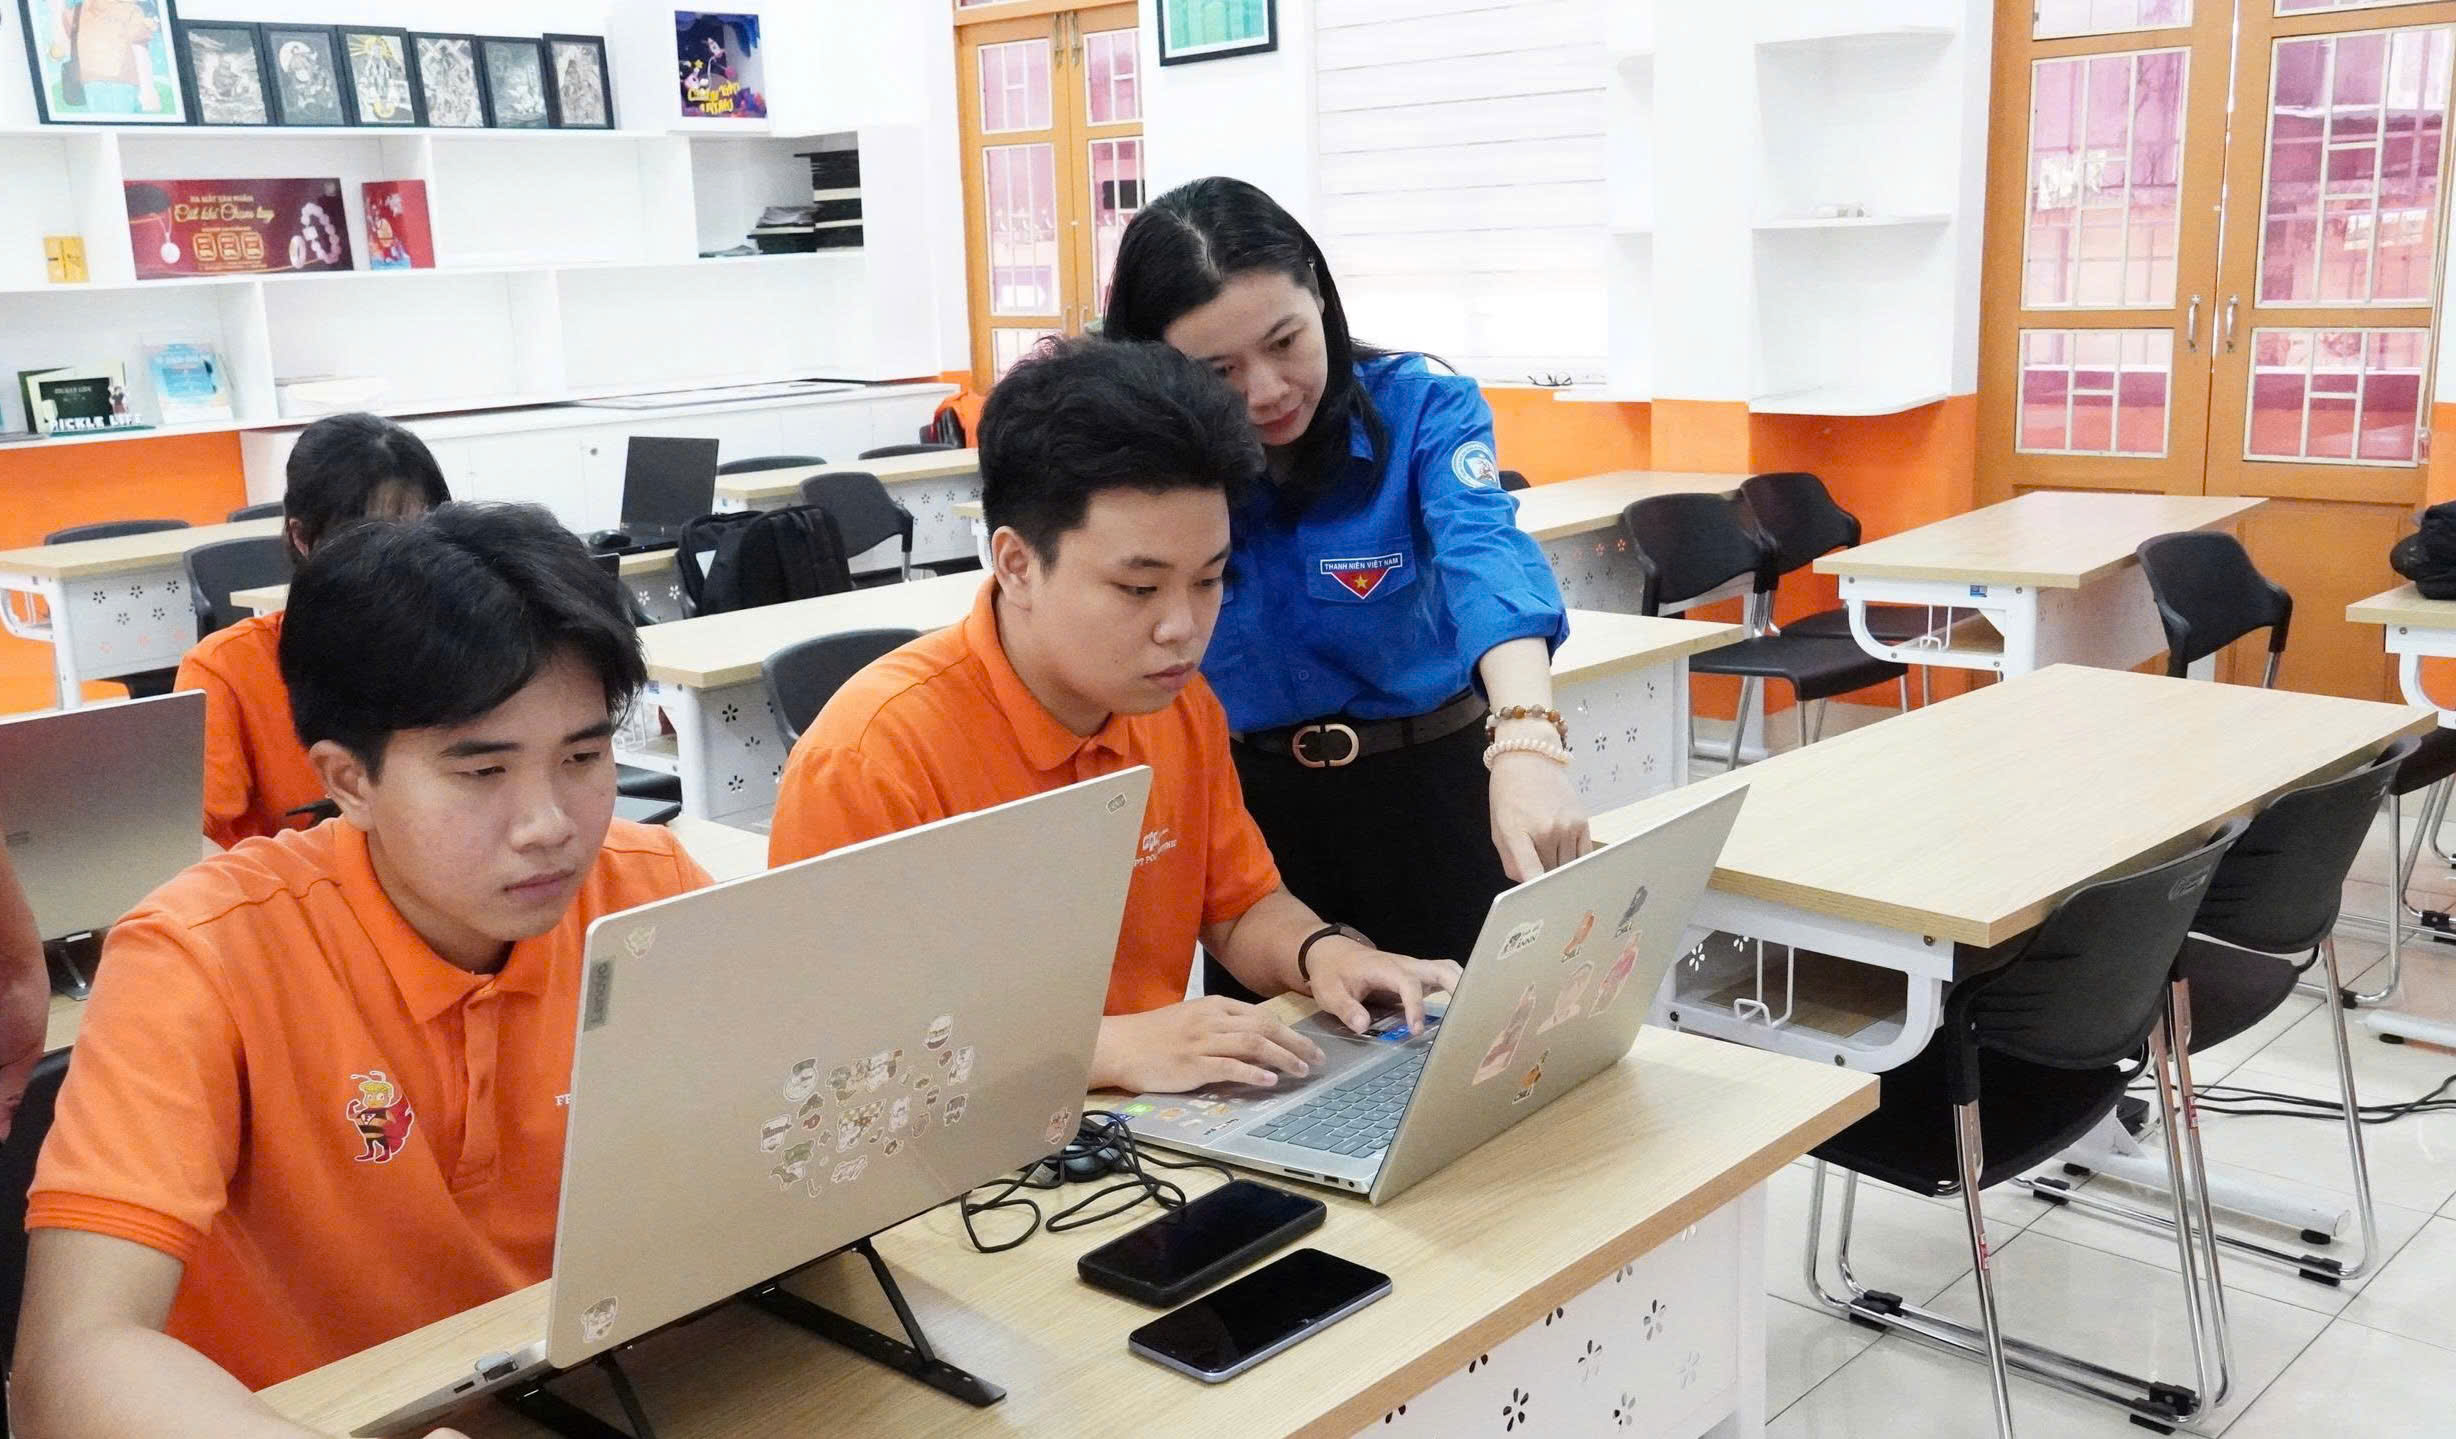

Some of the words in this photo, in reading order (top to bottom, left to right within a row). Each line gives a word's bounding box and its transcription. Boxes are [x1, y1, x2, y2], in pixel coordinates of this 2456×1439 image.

[1325, 563, 1348, 571] THANH
[1349, 561, 1366, 570] NIÊN
[1384, 557, 1399, 566] NAM
